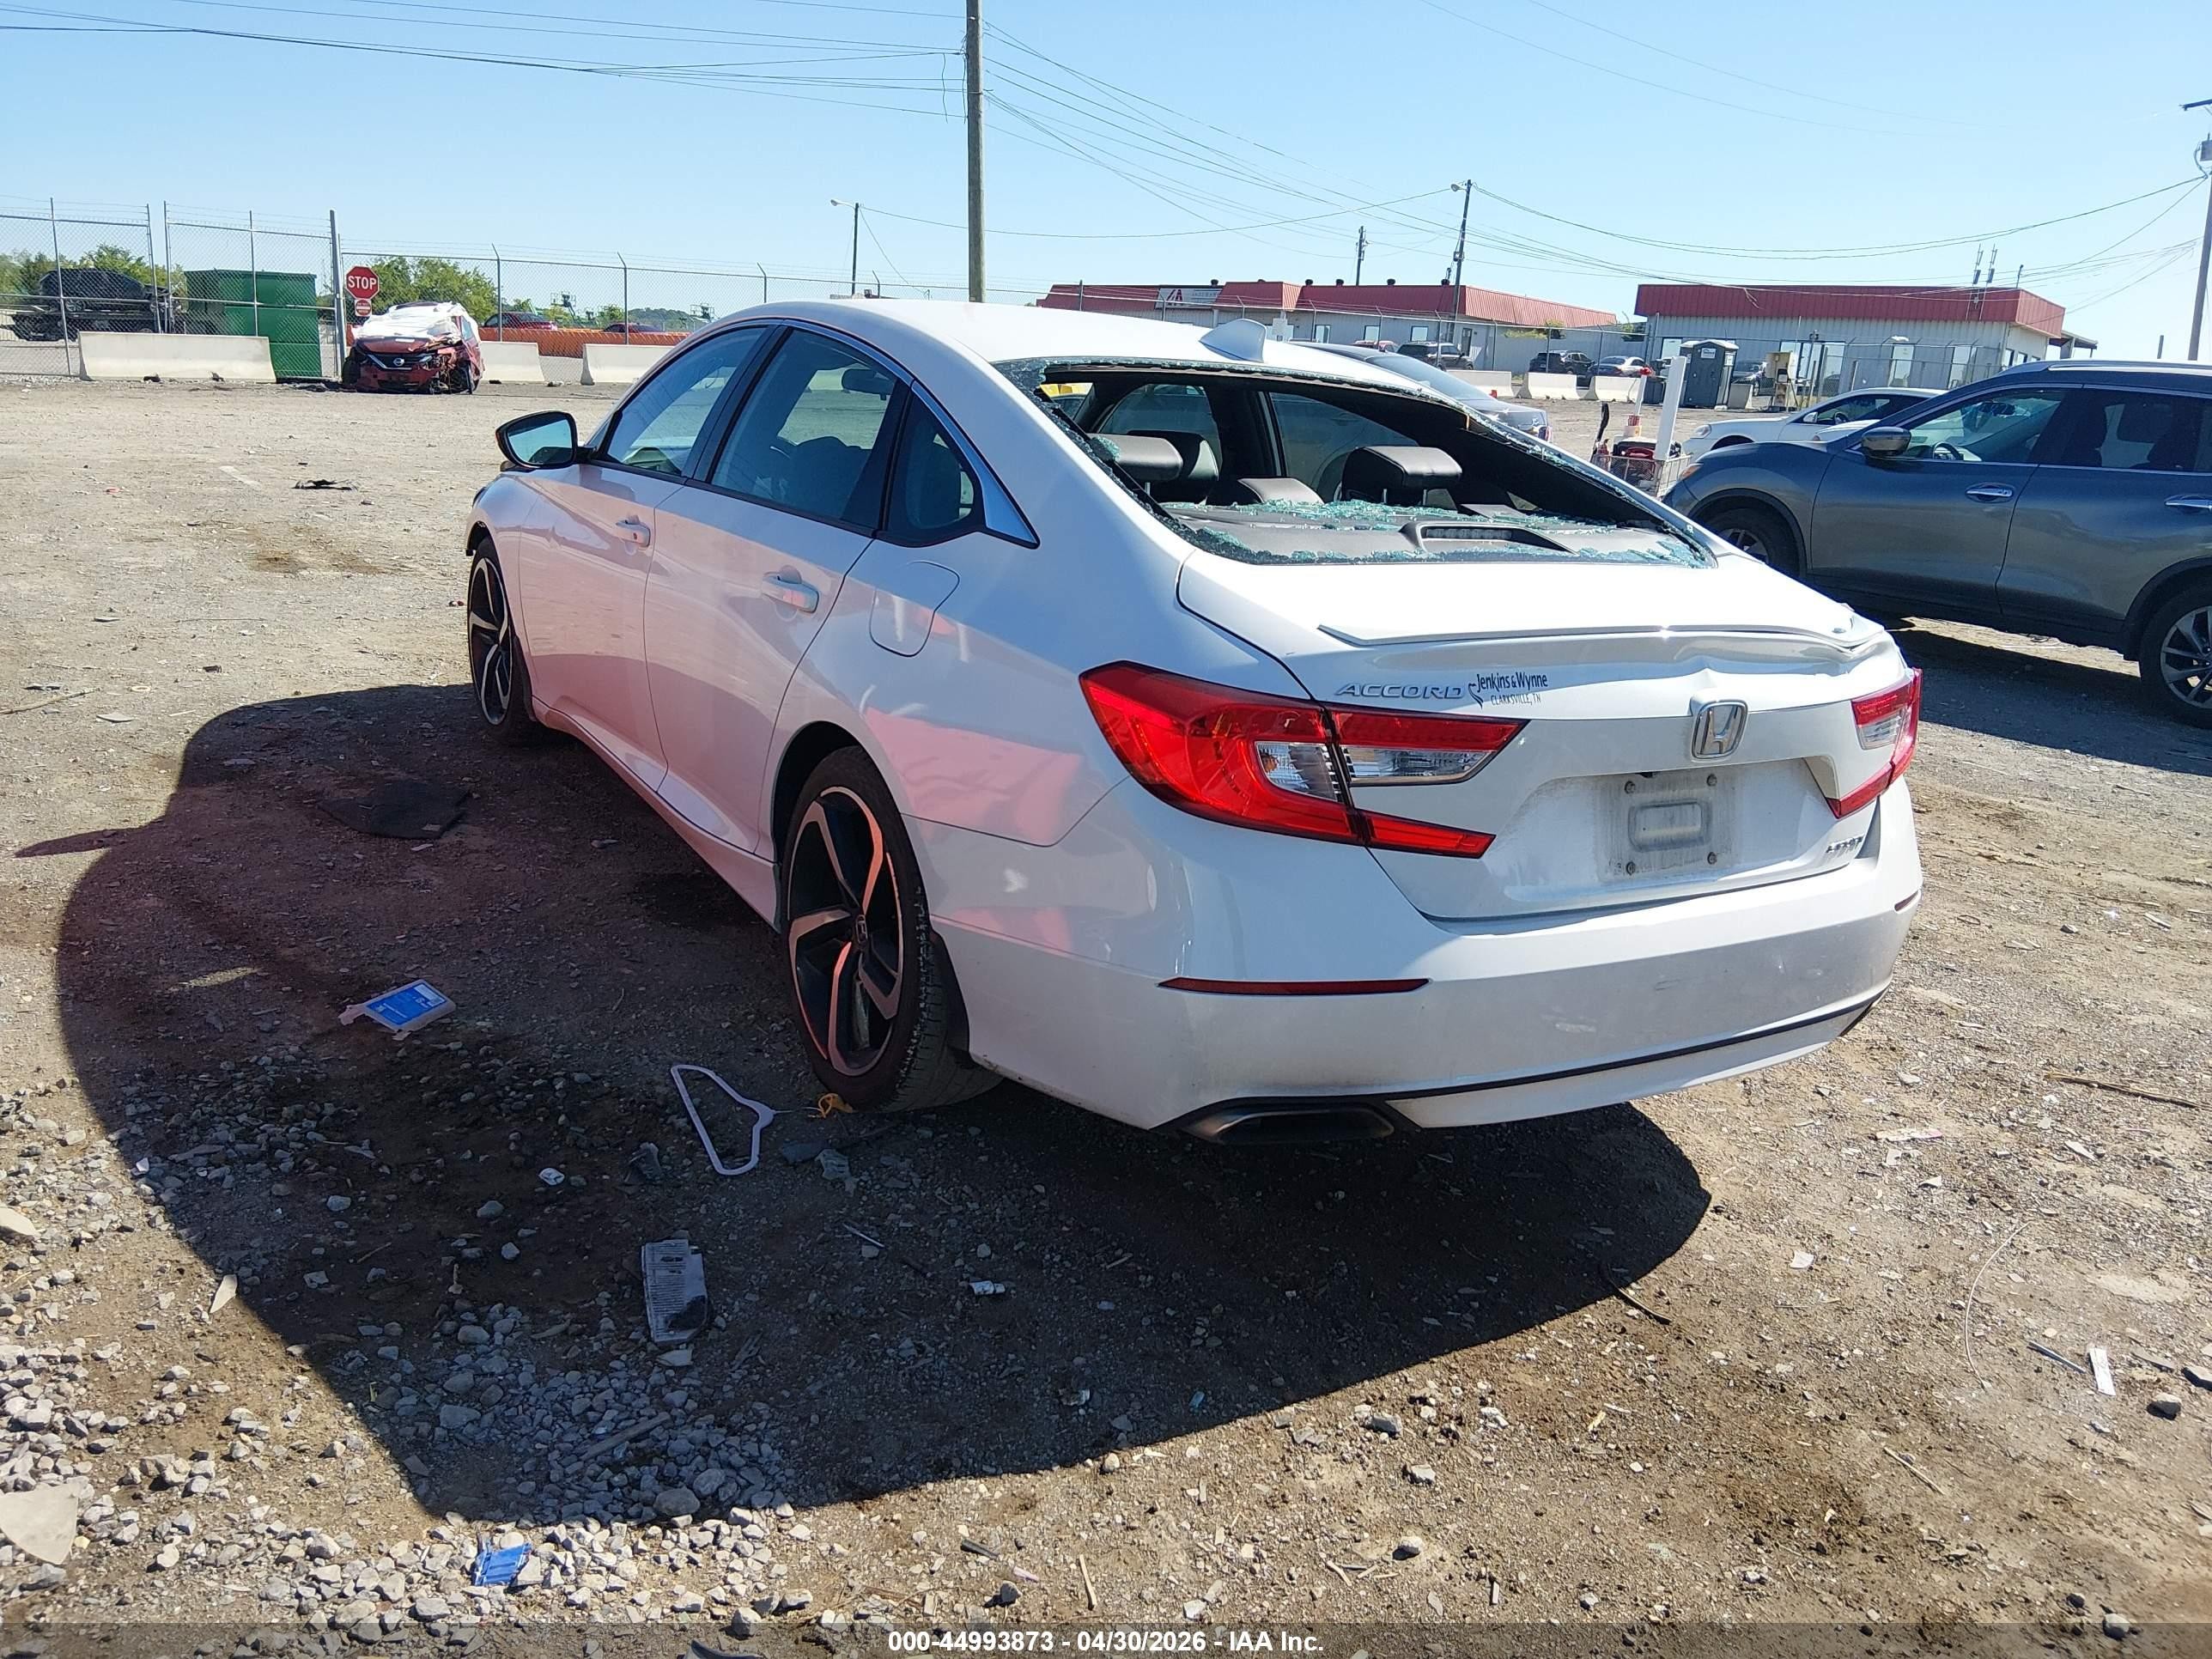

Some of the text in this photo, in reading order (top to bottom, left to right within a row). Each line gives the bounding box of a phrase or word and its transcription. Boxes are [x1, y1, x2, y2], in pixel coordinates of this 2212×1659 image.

[348, 275, 377, 290] STOP
[1336, 682, 1465, 700] ACCORD
[1491, 692, 1541, 706] CLARKSVILLE, TN
